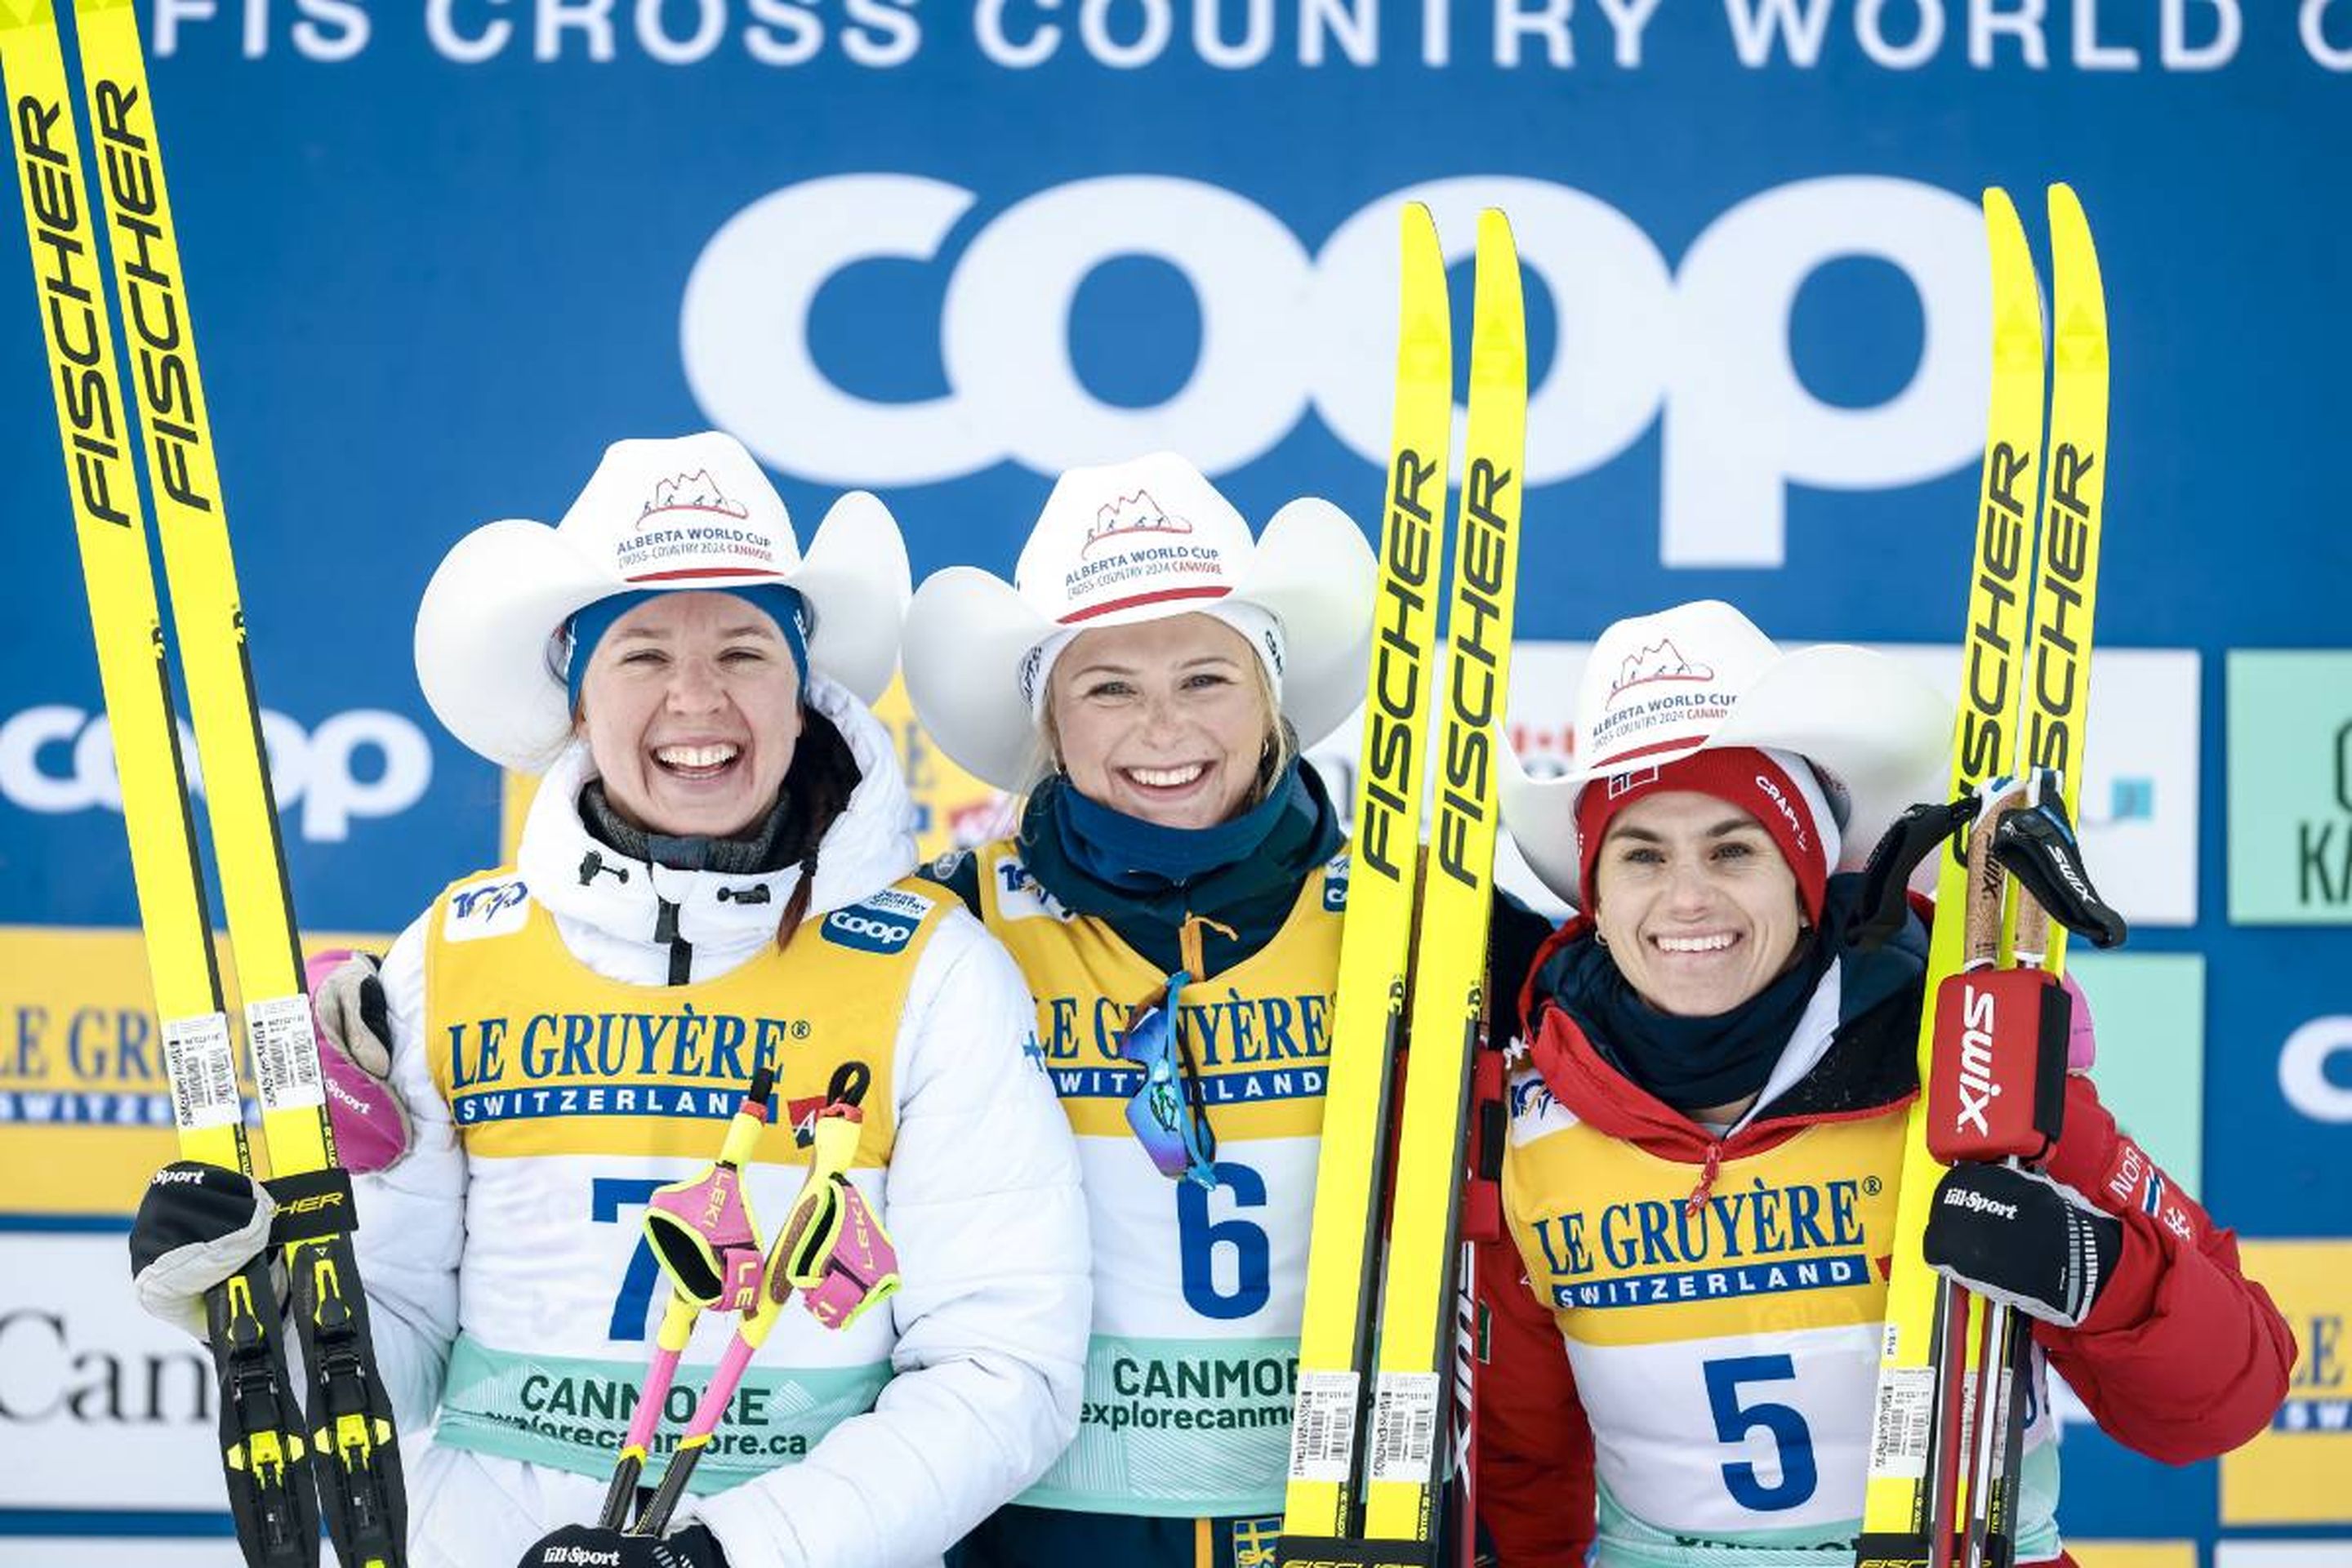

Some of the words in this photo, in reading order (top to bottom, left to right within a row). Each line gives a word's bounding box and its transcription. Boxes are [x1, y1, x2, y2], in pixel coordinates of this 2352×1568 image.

[155, 0, 371, 60] FIS
[425, 0, 921, 67] CROSS
[974, 0, 1663, 69] COUNTRY
[1725, 0, 2242, 71] WORLD
[16, 95, 132, 528] FISCHER
[95, 79, 212, 513] FISCHER
[679, 173, 2048, 569] coop
[617, 531, 684, 555] ALBERTA
[687, 528, 744, 542] WORLD
[746, 532, 772, 548] CUP
[1065, 555, 1129, 586] ALBERTA
[1130, 546, 1189, 564] WORLD
[1192, 546, 1219, 560] CUP
[1361, 449, 1437, 883] FISCHER
[1438, 457, 1512, 889] FISCHER
[1953, 441, 2030, 867] SCHER
[1648, 694, 1706, 711] WORLD
[1756, 776, 1800, 831] CRAFT
[830, 911, 910, 943] coop
[448, 1018, 508, 1089] LE
[462, 1089, 745, 1122] SWITZERLAN
[592, 1178, 683, 1341] 7
[1177, 1162, 1270, 1320] 6
[1534, 1211, 1594, 1277] LE
[1560, 1260, 1852, 1308] SWITZERLAND
[1080, 1400, 1296, 1431] explorecanm
[1704, 1353, 1819, 1512] 5
